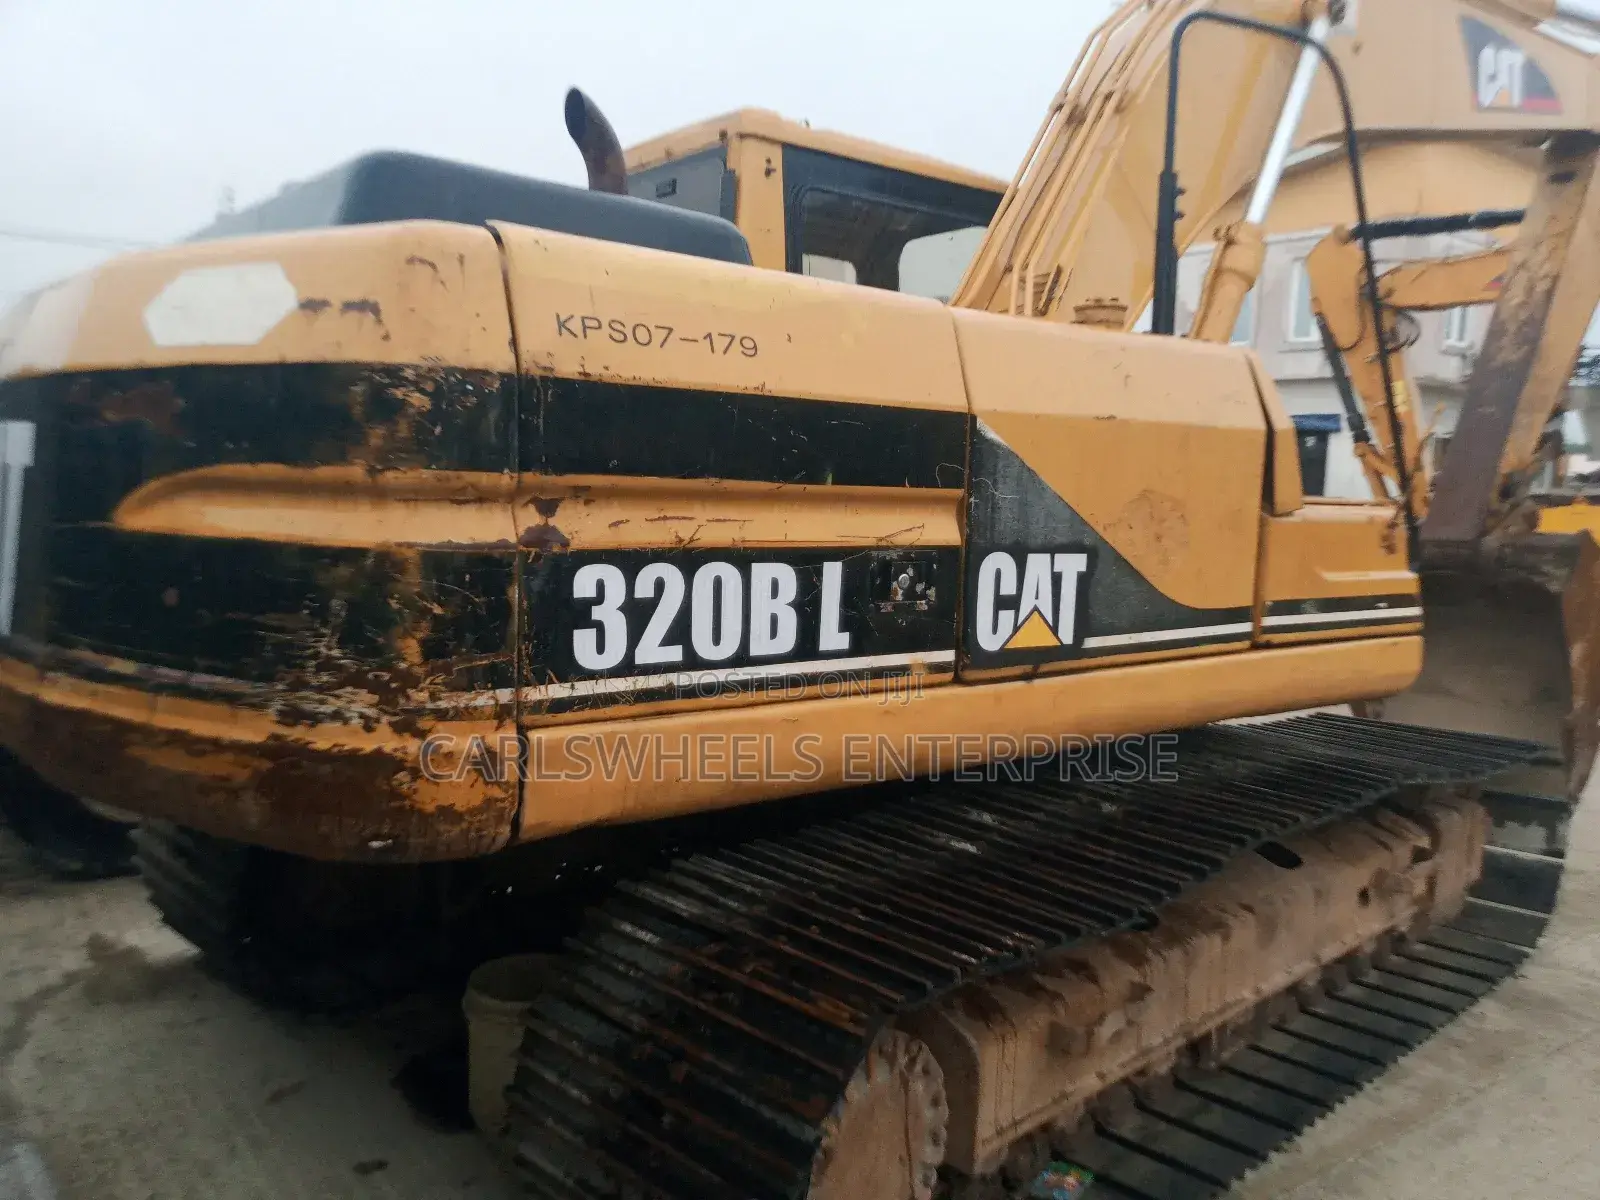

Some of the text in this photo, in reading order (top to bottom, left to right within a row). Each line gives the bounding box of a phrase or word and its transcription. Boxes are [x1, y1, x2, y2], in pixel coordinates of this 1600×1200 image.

[1478, 43, 1523, 108] CAT
[555, 312, 758, 358] KPS07-179
[572, 561, 851, 671] 320B L
[976, 551, 1088, 652] CAT
